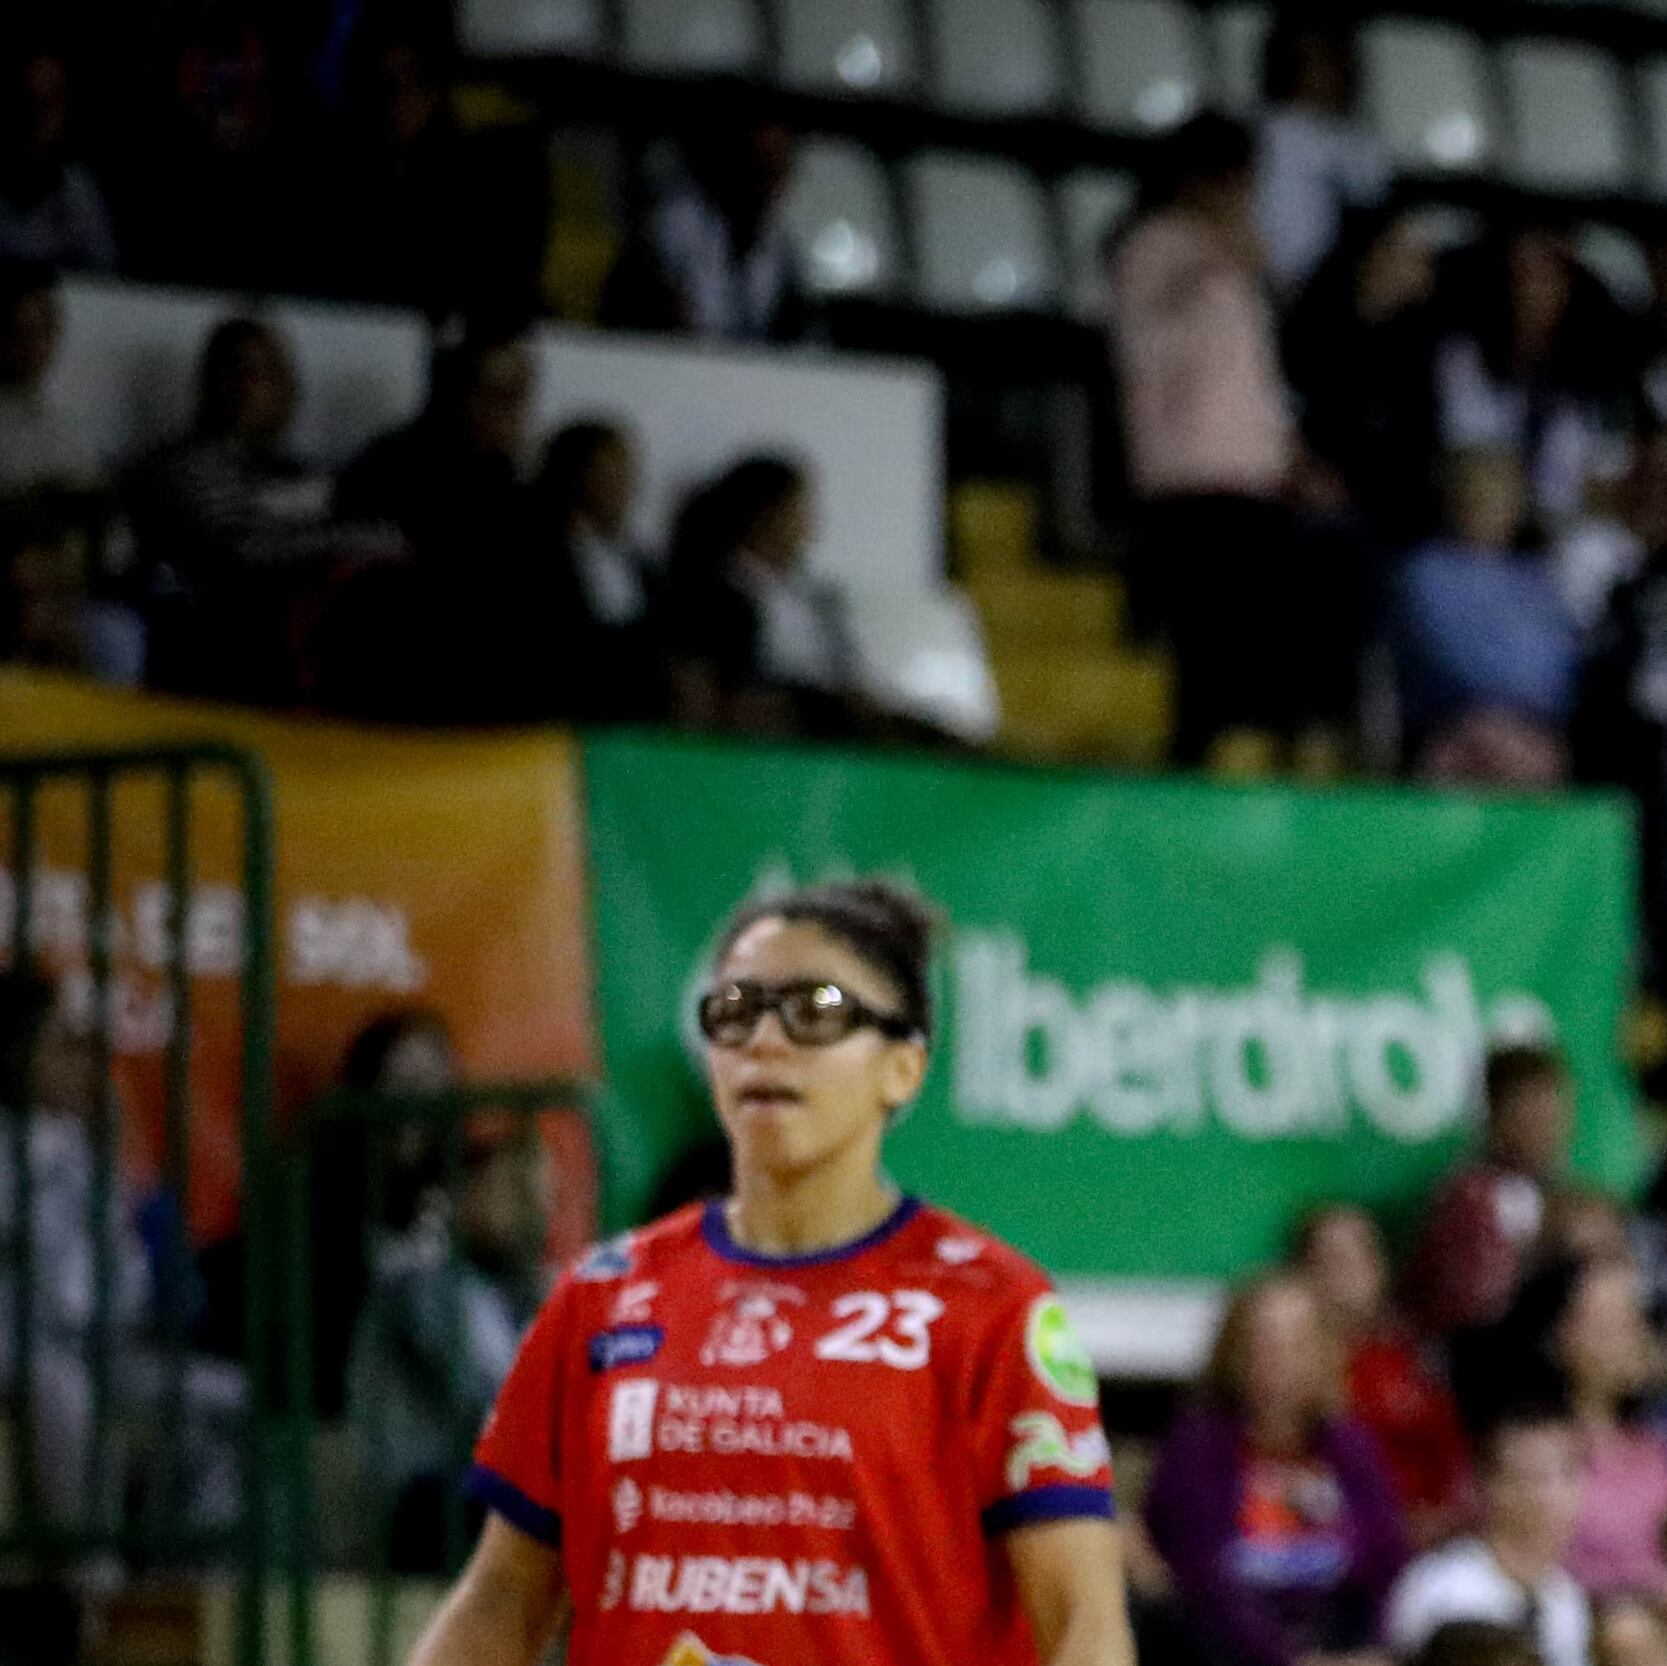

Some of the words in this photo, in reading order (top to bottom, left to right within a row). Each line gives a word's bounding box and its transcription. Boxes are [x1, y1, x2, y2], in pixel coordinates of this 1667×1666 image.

[814, 1289, 945, 1371] 23
[656, 1416, 703, 1452] DE
[709, 1419, 854, 1462] GALICIA
[630, 1553, 871, 1621] RUBENSA
